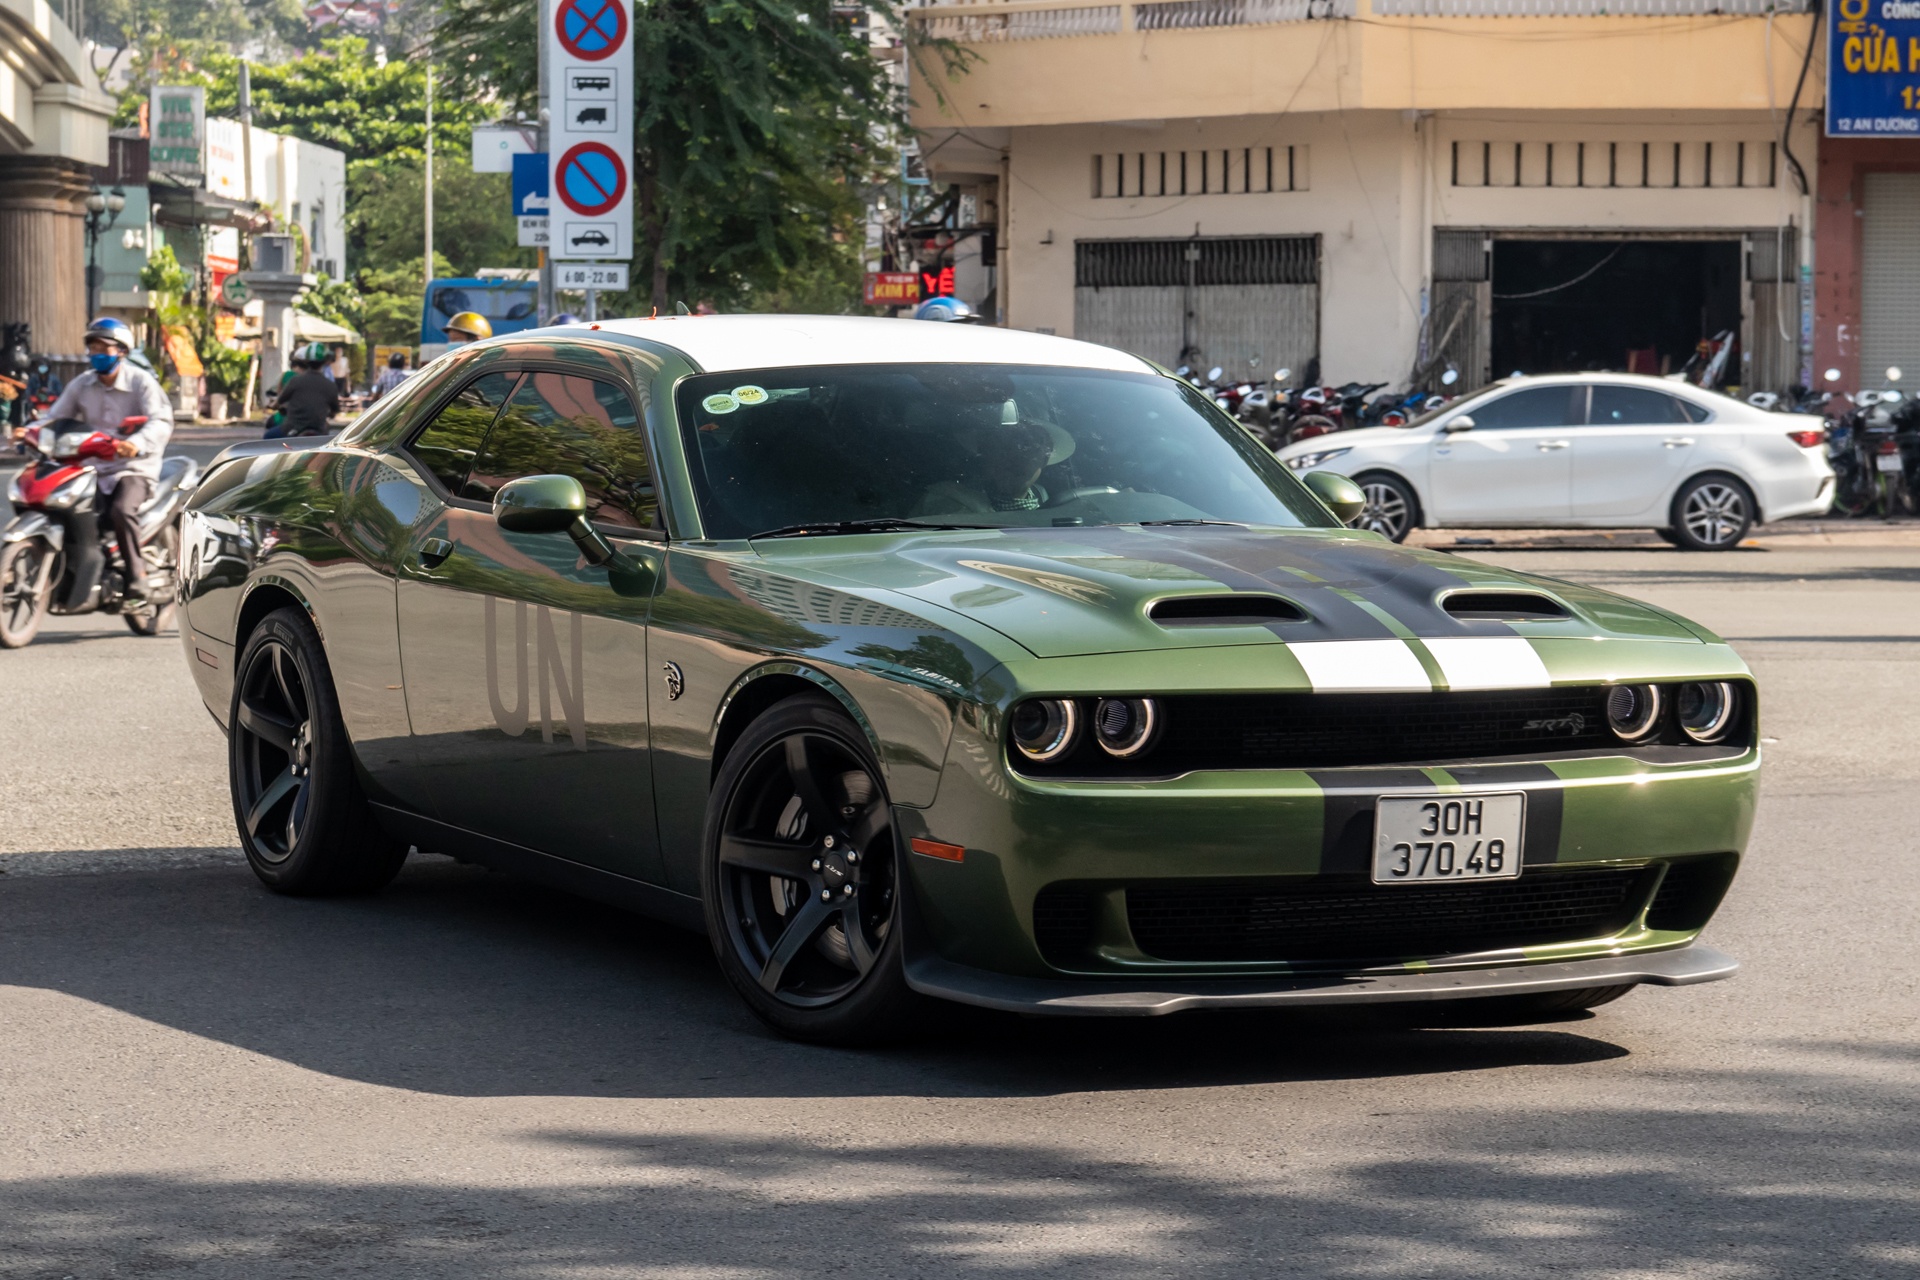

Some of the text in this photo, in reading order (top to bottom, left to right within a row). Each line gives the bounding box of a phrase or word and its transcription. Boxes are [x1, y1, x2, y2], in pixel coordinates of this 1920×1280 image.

[1843, 23, 1900, 73] CỬA
[1838, 118, 1851, 130] 12
[1853, 118, 1872, 130] AN
[150, 147, 200, 163] COFFEE
[875, 284, 903, 298] KIM
[1421, 799, 1483, 836] 30H
[1392, 838, 1505, 876] 370.48
